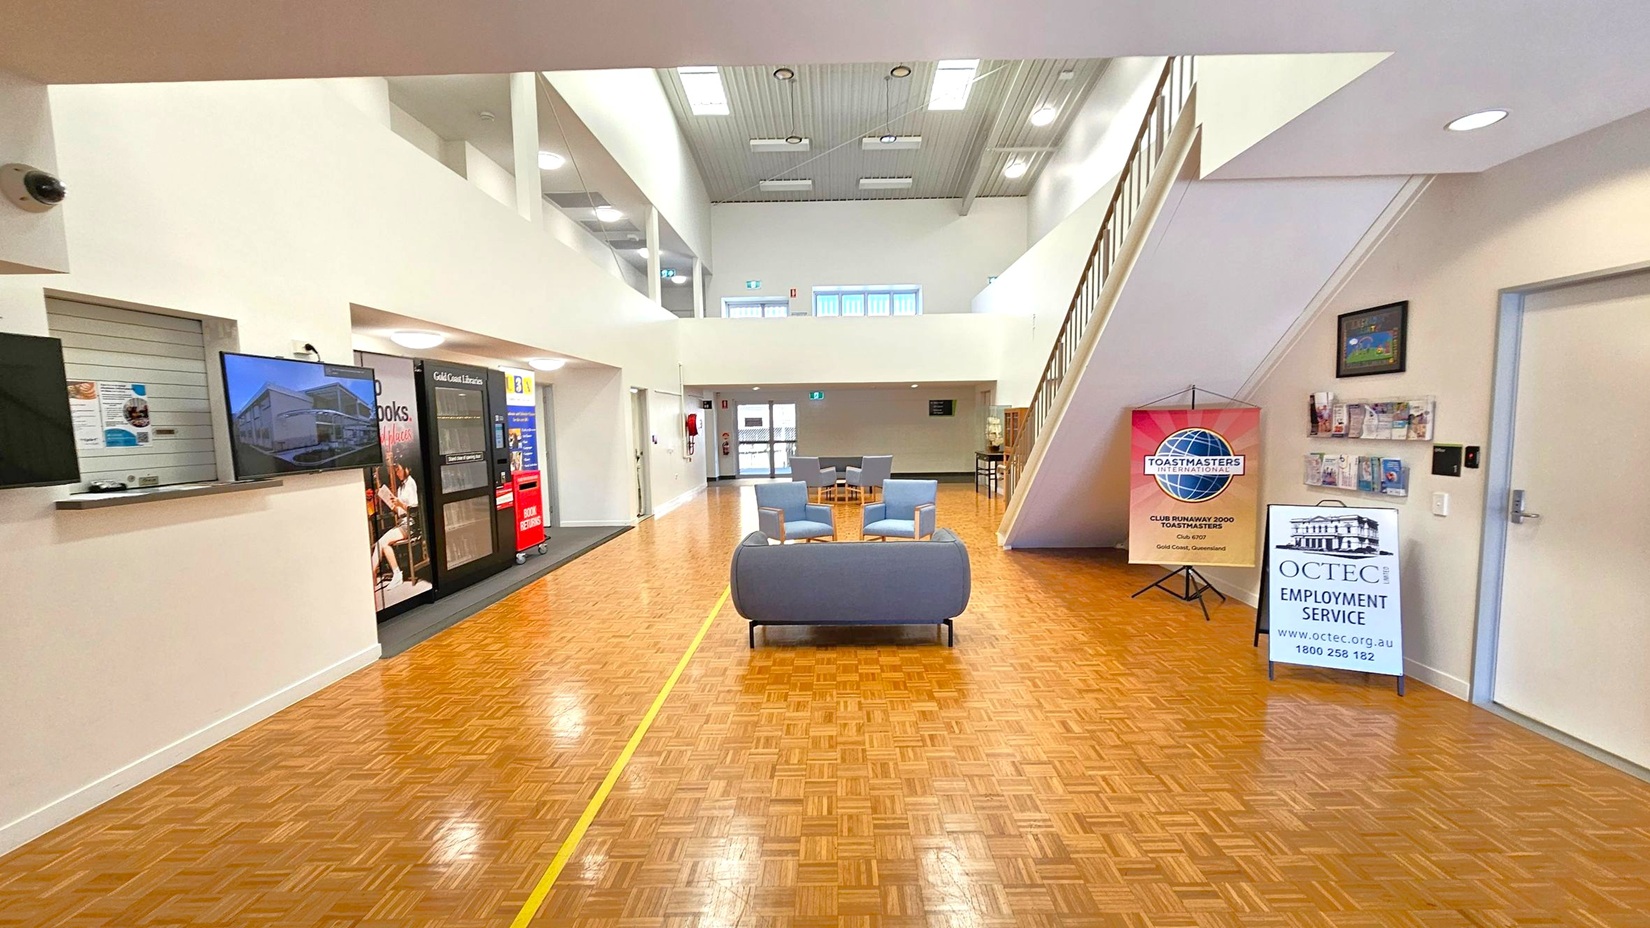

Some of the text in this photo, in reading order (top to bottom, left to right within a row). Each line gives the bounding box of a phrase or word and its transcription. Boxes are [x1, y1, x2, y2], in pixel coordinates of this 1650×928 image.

[433, 371, 483, 385] Gold Coast Libraries
[377, 400, 412, 422] ooks.
[386, 423, 412, 453] places
[1148, 458, 1241, 467] TOASTMASTERS
[523, 505, 537, 519] BOOK
[1171, 515, 1212, 523] RUNAWAY
[520, 515, 542, 531] RETURNS
[1279, 559, 1380, 584] OCTEC
[1382, 566, 1390, 585] LIMITED
[1280, 587, 1388, 609] EMPLOYMENT
[1302, 607, 1366, 626] SERVICE
[1277, 629, 1393, 648] www.octec.org.au
[1296, 645, 1375, 661] 1800 258 182
